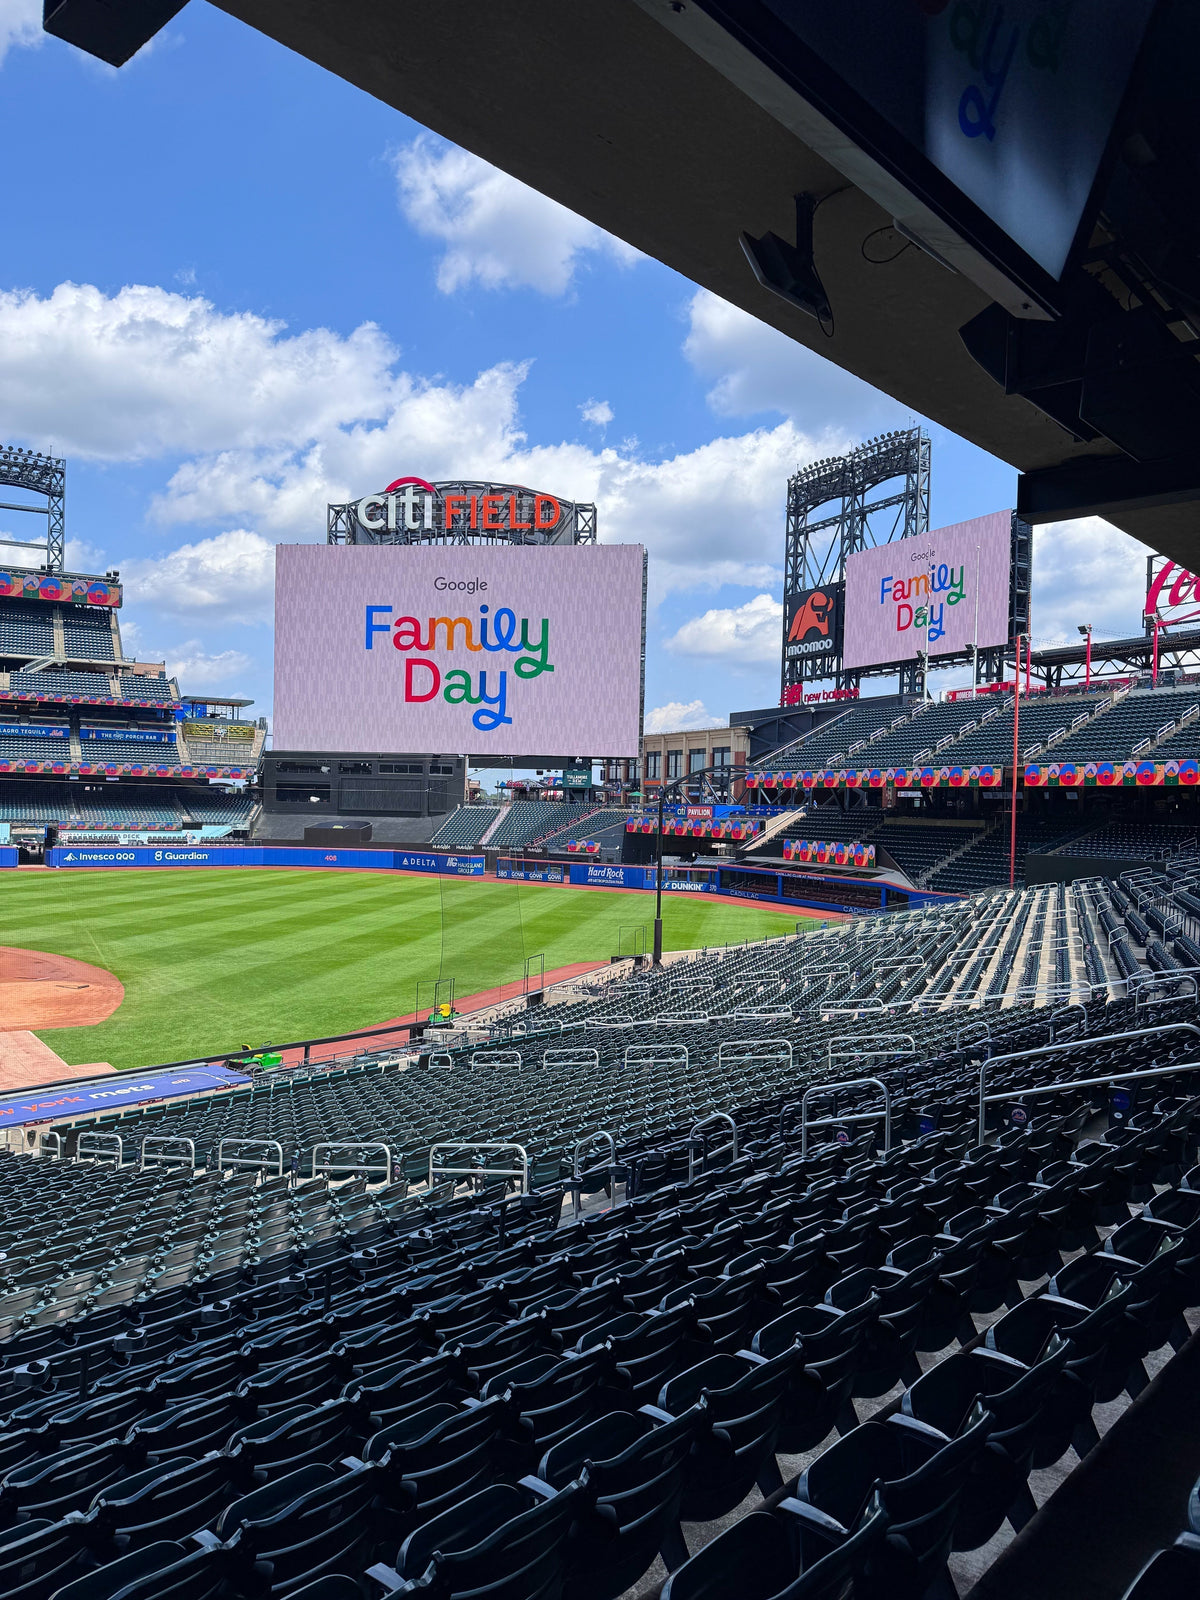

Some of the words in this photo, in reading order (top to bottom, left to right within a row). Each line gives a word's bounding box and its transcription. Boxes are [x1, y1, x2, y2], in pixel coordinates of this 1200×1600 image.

[445, 494, 561, 530] FIELD
[434, 576, 488, 595] Google
[880, 564, 966, 606] Family
[897, 603, 946, 642] Day
[365, 604, 555, 679] Family
[788, 639, 833, 656] moomoo
[404, 658, 513, 731] Day
[803, 692, 822, 702] new
[822, 687, 860, 701] balance
[687, 808, 711, 817] PAVILION
[79, 852, 115, 861] Invesco
[116, 852, 136, 861] QQQ
[165, 851, 208, 860] Guardian
[411, 858, 436, 867] DELTA
[587, 866, 606, 877] Hard
[606, 867, 625, 880] Rock
[729, 890, 760, 900] CADILLAC
[842, 905, 883, 916] CADILLAC
[88, 1084, 155, 1100] mets
